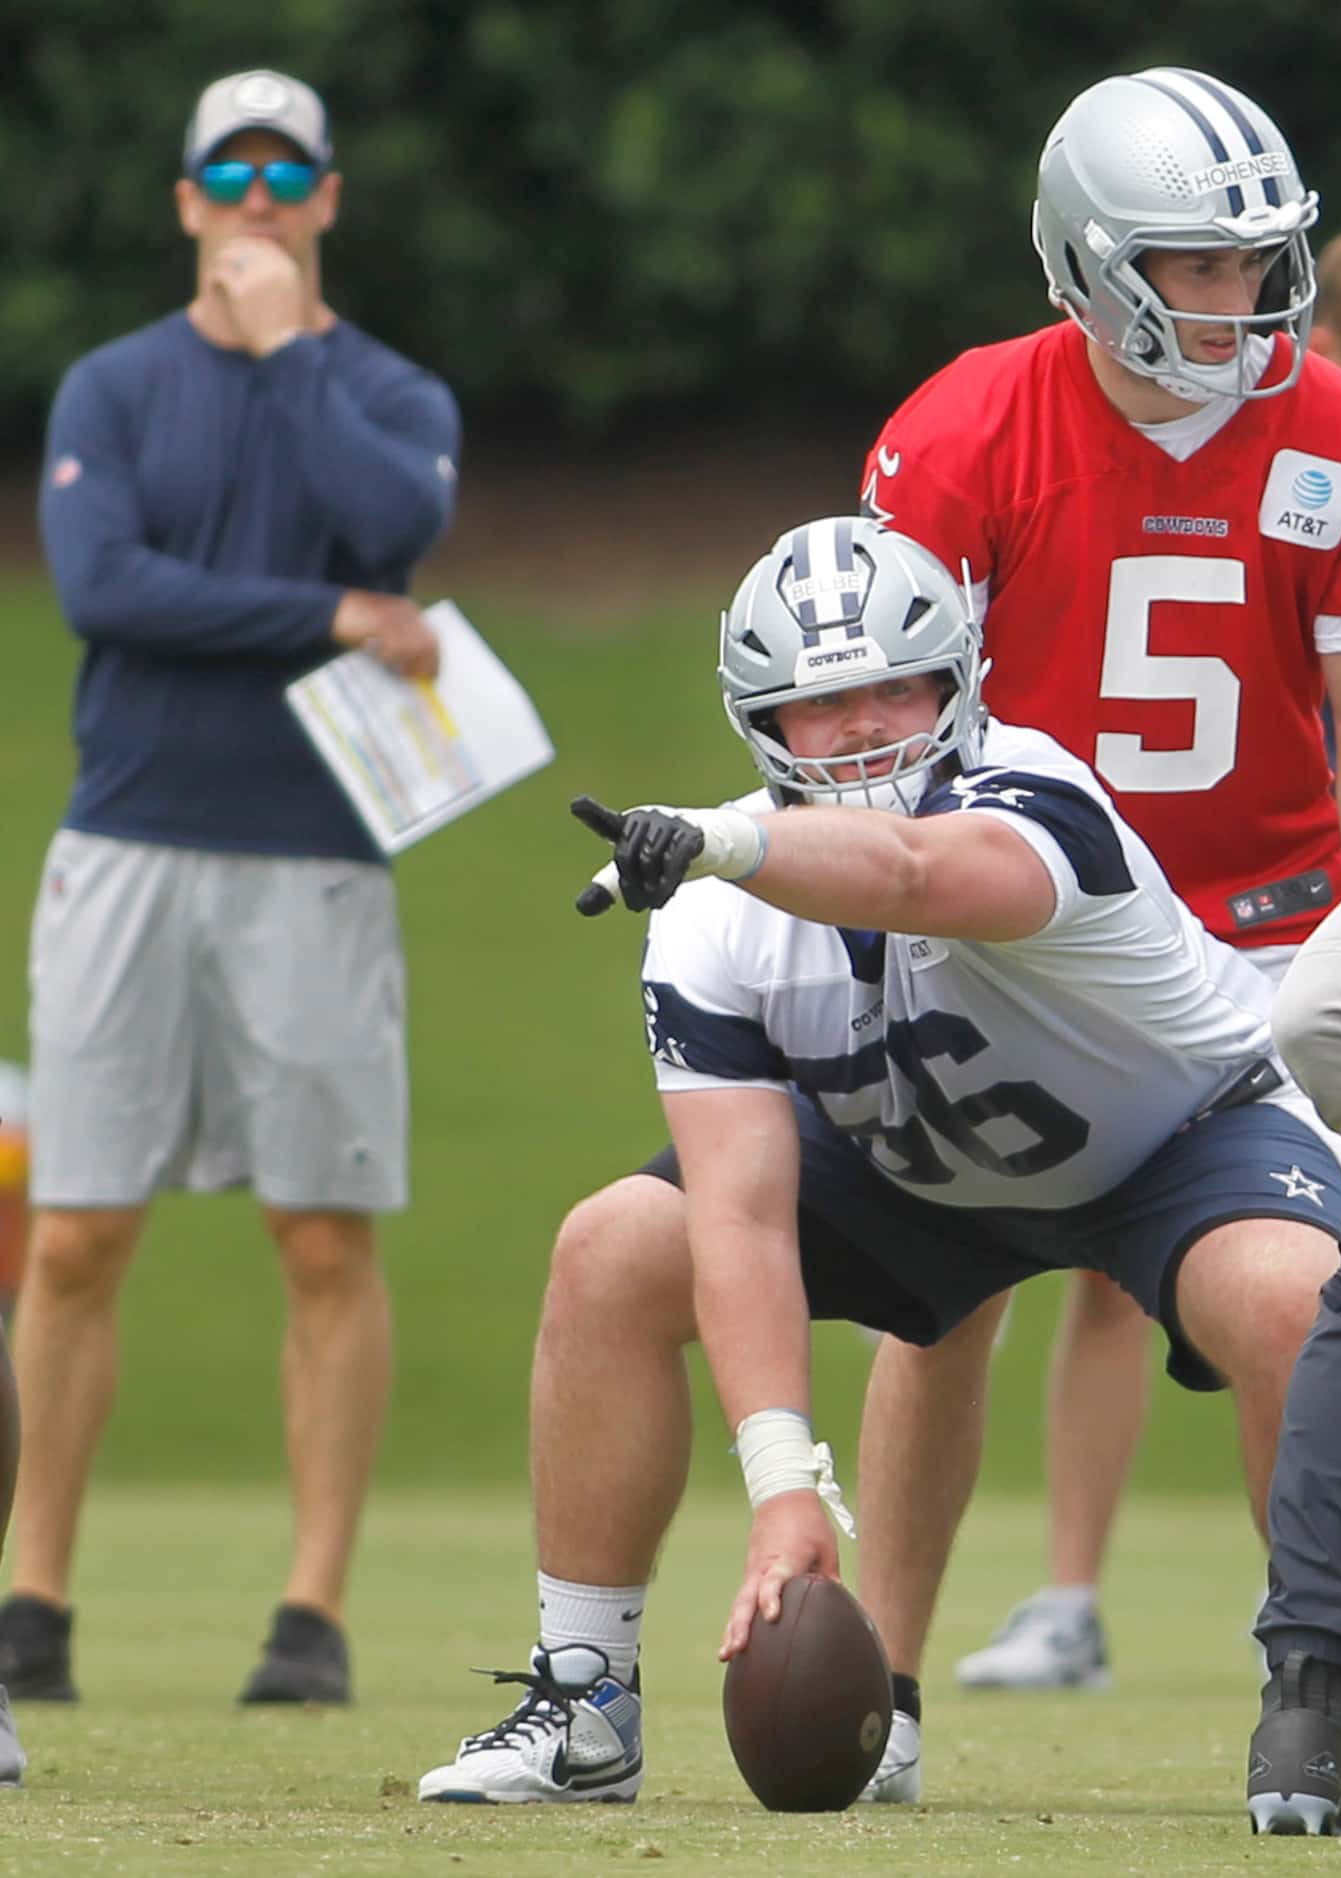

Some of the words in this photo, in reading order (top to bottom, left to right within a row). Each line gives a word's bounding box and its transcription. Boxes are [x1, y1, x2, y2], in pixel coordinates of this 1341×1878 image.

[1143, 515, 1229, 538] COWBOYS
[1277, 511, 1328, 538] AT&T
[807, 646, 867, 667] COWBOYS
[1095, 554, 1246, 792] 5
[787, 1009, 1091, 1186] 56
